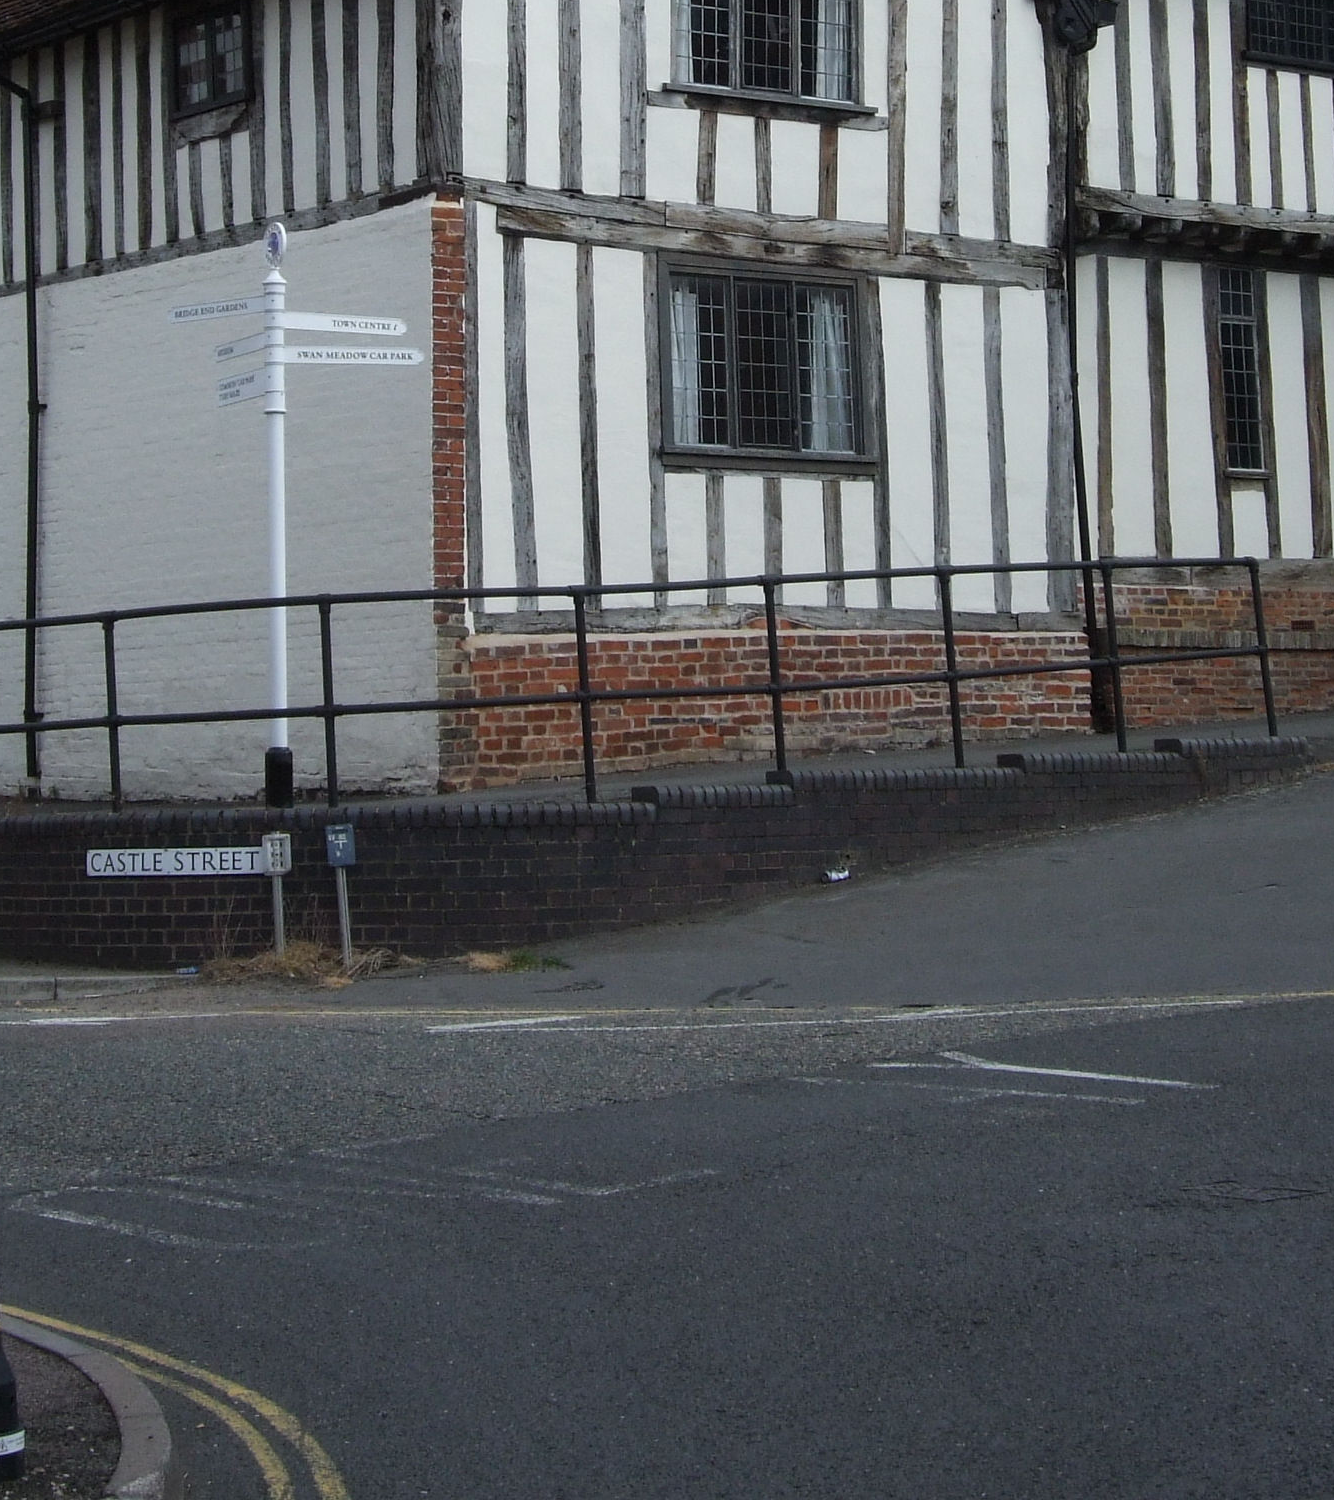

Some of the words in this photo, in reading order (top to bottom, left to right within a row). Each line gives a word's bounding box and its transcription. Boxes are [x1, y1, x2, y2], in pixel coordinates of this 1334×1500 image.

[174, 308, 199, 319] BRIDGE
[200, 306, 215, 315] END
[216, 301, 248, 314] GARDENS
[332, 319, 357, 329] TOWN
[358, 321, 392, 331] CENTRE
[297, 351, 323, 359] SWAN
[325, 351, 367, 360] MEADOW
[369, 352, 388, 360] CAR
[390, 352, 413, 361] PARK
[90, 852, 163, 873] CASTLE
[173, 850, 260, 872] STREET
